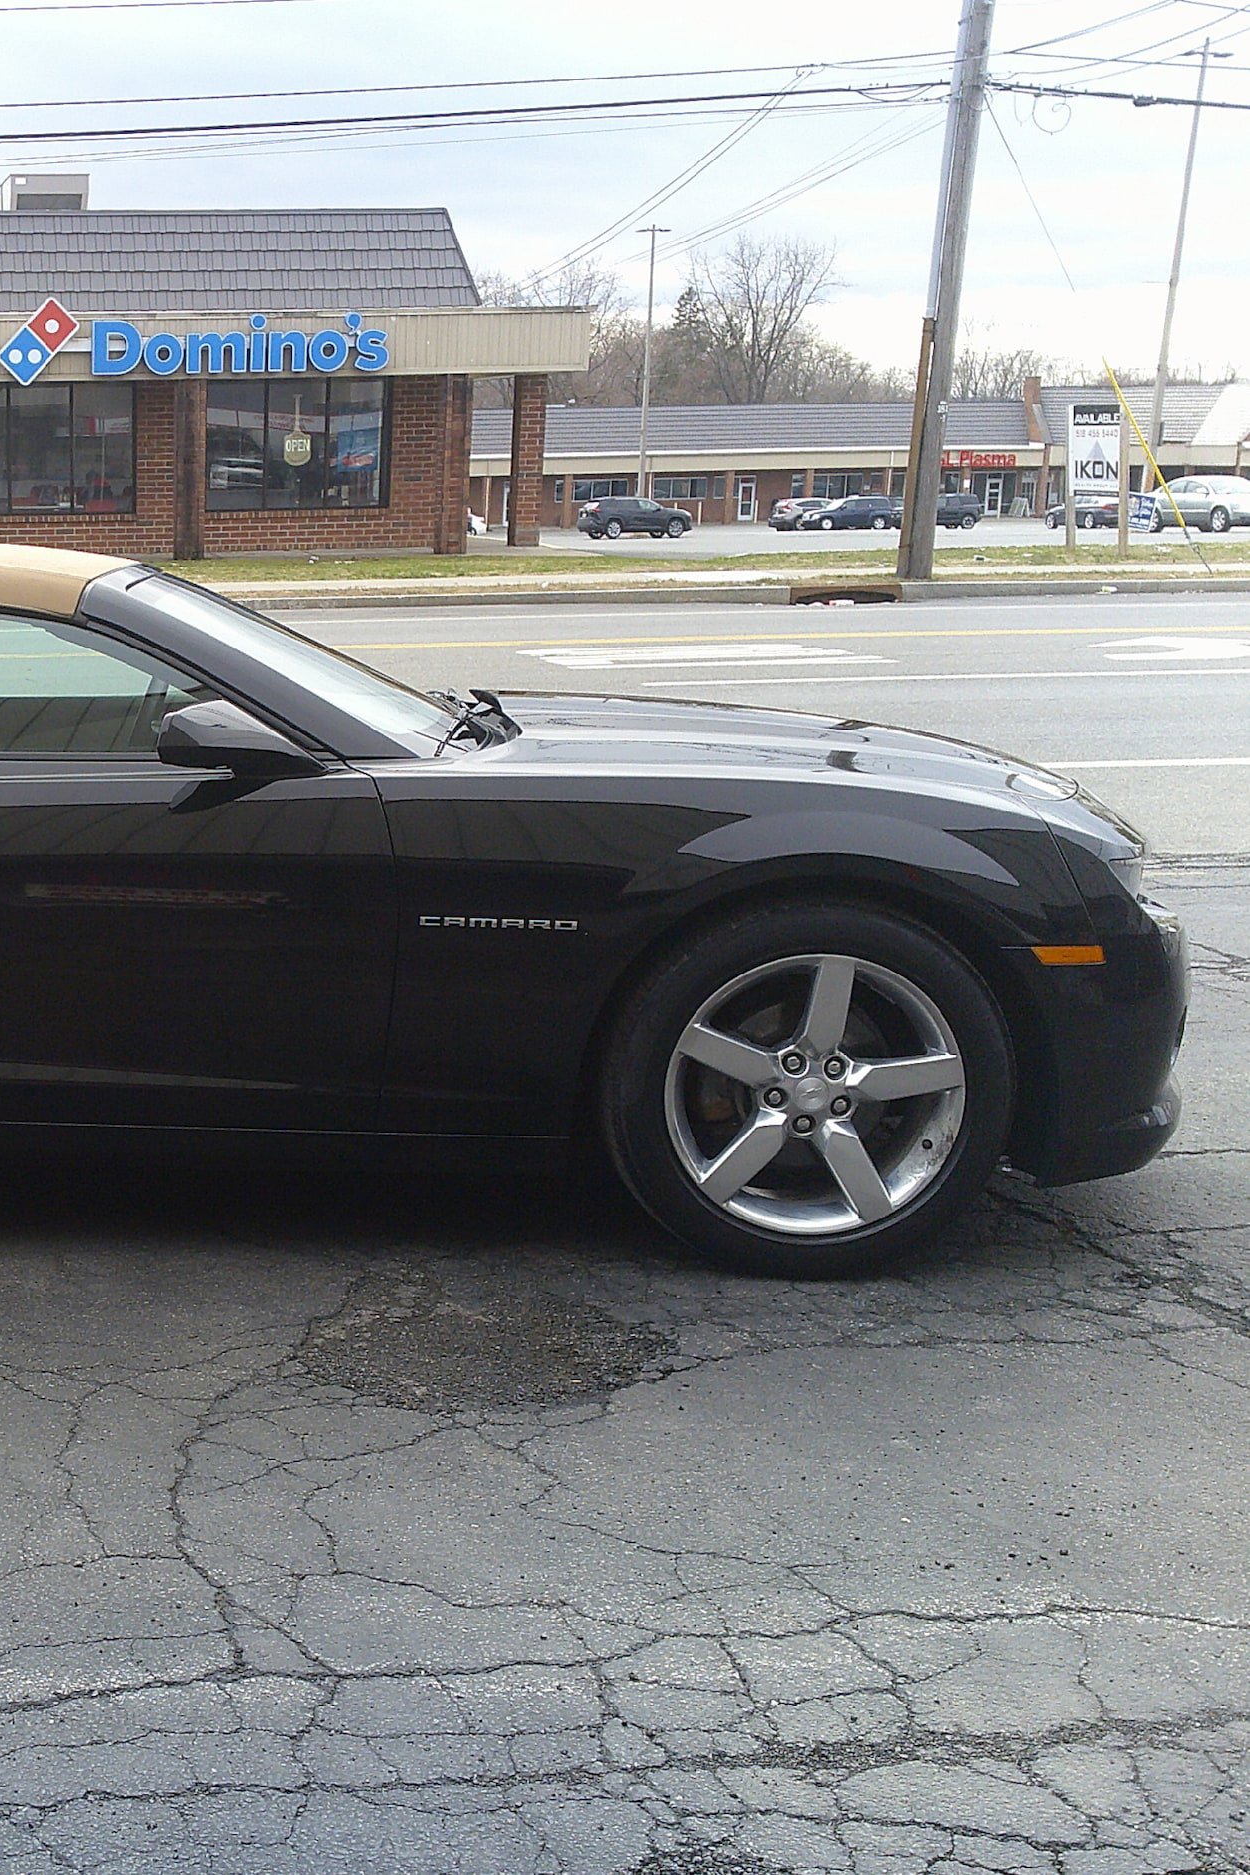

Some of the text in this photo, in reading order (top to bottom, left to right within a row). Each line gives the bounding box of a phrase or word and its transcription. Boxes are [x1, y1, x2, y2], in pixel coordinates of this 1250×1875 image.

[91, 311, 390, 376] Domino's
[1074, 412, 1120, 424] AVAILABLE
[285, 439, 310, 452] OPEN
[958, 449, 1016, 468] Plasma
[1075, 460, 1118, 480] IKON
[419, 915, 578, 931] CAMARO
